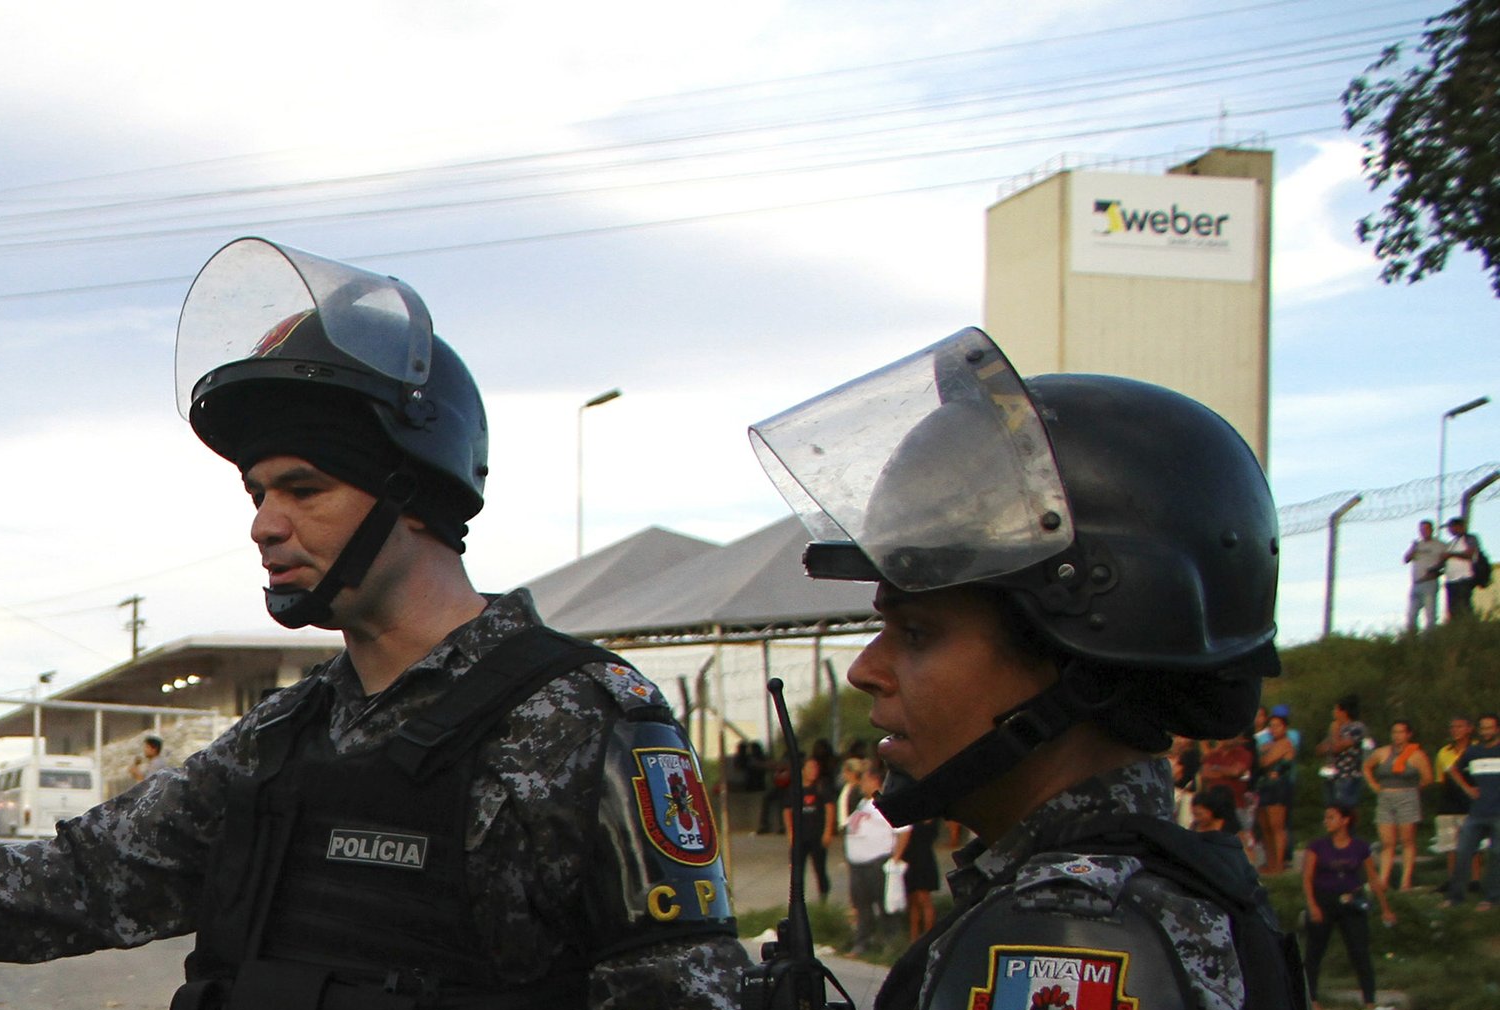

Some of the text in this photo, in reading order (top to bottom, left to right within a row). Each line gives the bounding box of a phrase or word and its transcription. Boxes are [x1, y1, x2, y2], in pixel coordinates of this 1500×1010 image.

[1121, 204, 1229, 236] weber
[647, 755, 692, 771] PMAM
[330, 835, 420, 865] POLÍCIA
[678, 834, 705, 846] CPE
[1005, 958, 1111, 984] PMAM
